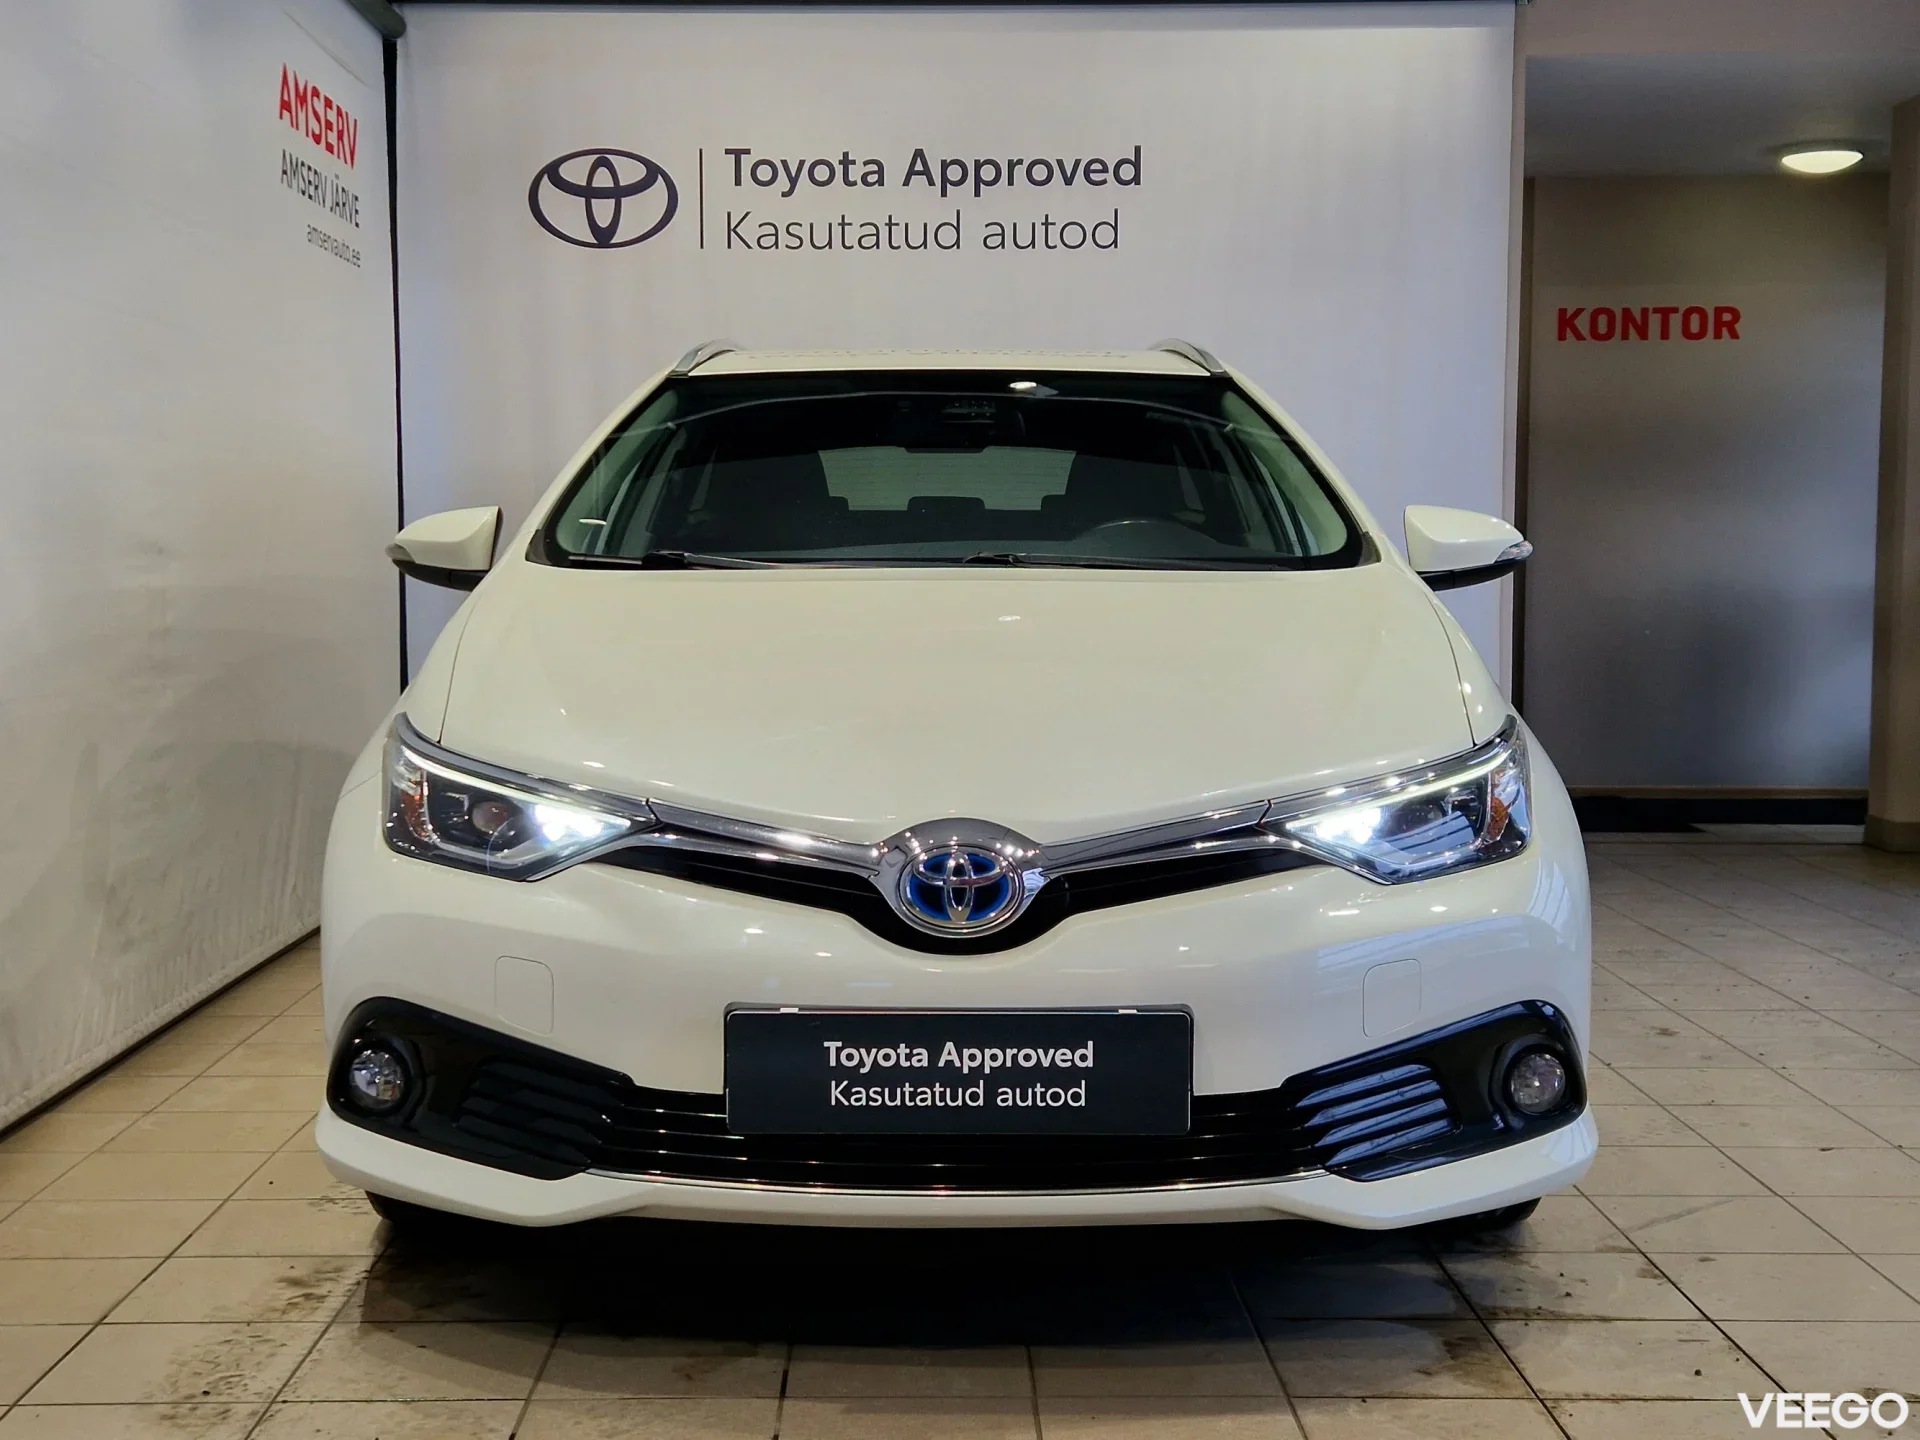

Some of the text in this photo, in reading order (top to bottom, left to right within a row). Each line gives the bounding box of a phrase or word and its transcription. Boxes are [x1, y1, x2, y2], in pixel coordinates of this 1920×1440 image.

[279, 63, 358, 170] AMSERV
[281, 149, 360, 229] AMSERV JÄRVE
[725, 145, 1144, 198] Toyota Approved
[306, 223, 361, 268] amservauto.ee
[726, 209, 1120, 251] Kasutatud autod
[1557, 306, 1742, 342] KONTOR
[824, 1040, 1094, 1074] Toyota Approved
[830, 1080, 1086, 1107] Kasutatud autod
